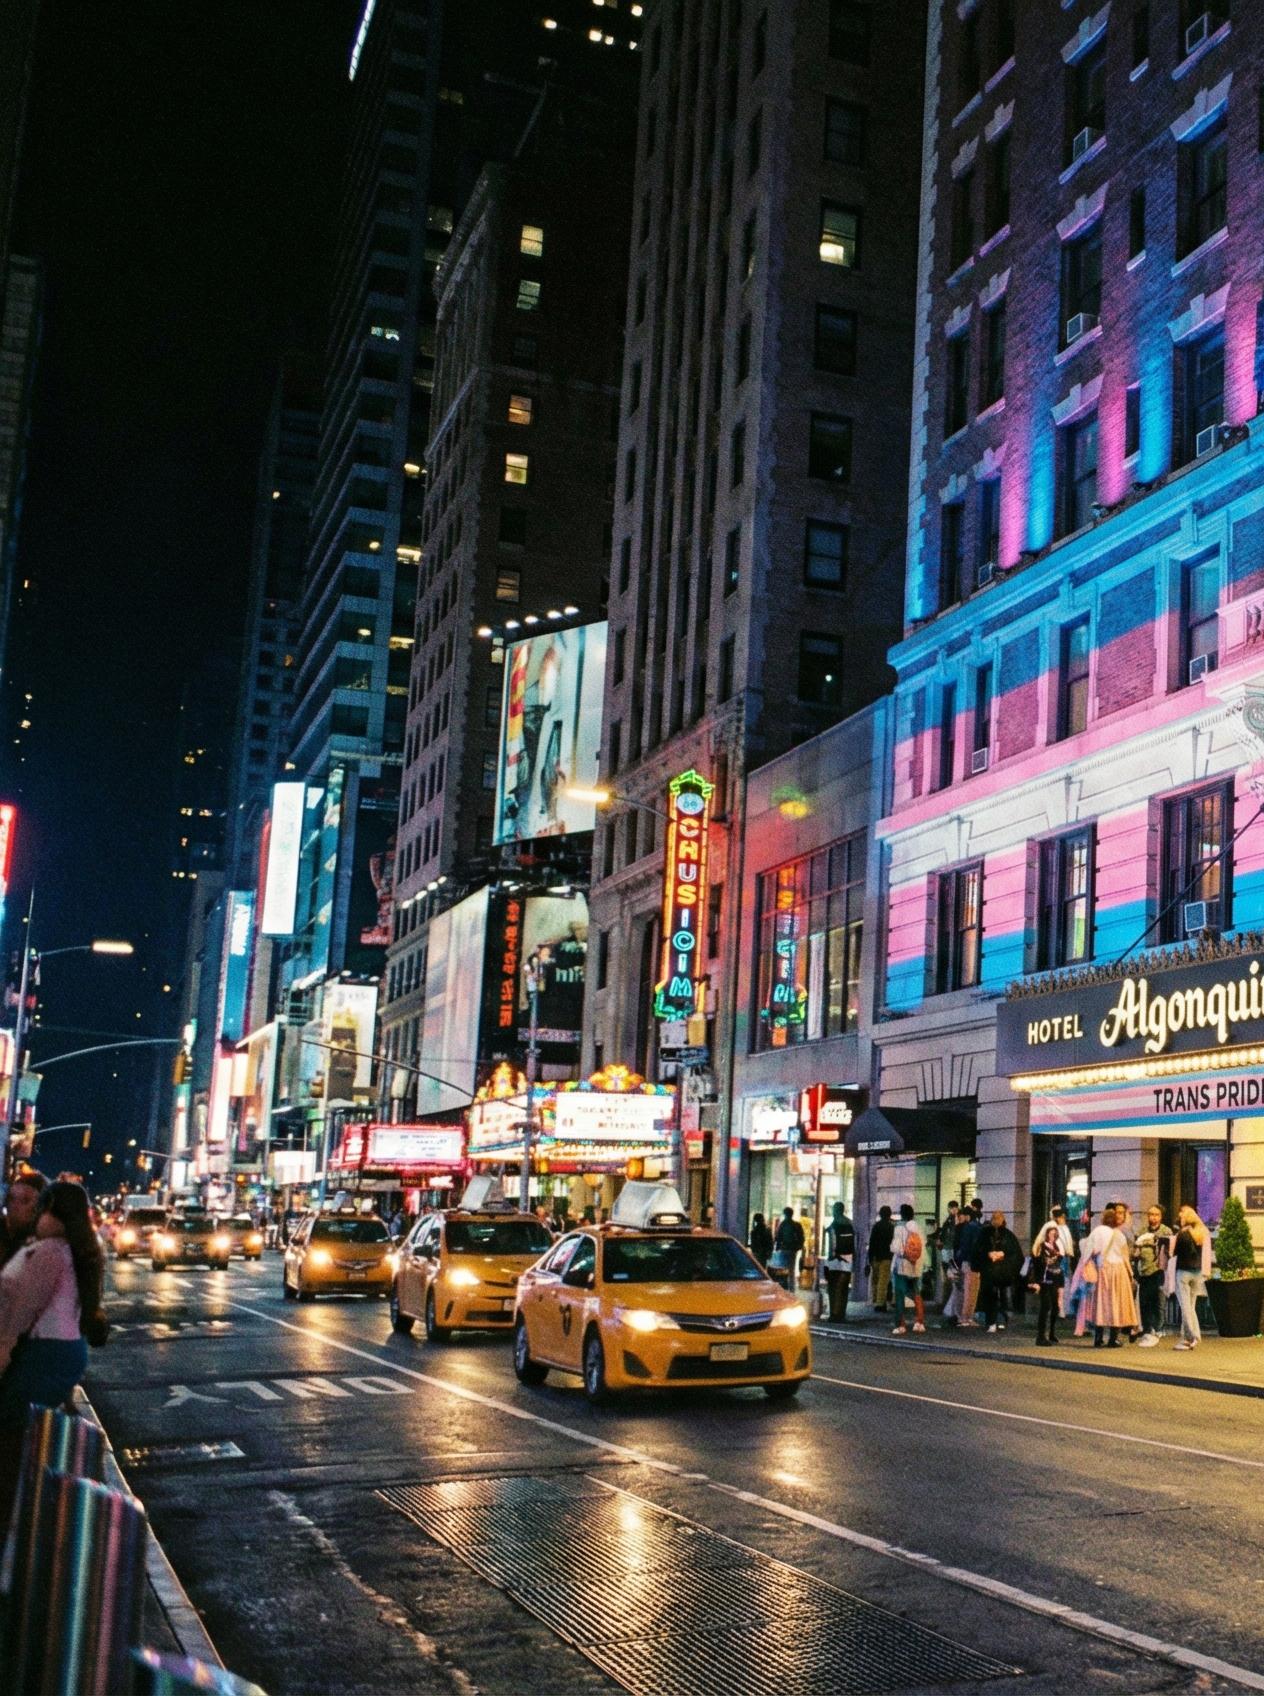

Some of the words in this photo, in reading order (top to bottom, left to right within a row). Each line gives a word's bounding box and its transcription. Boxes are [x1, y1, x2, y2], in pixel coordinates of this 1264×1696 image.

[1027, 1013, 1083, 1045] HOTEL
[1153, 1082, 1210, 1114] TRANS
[161, 1376, 417, 1409] ONLY
